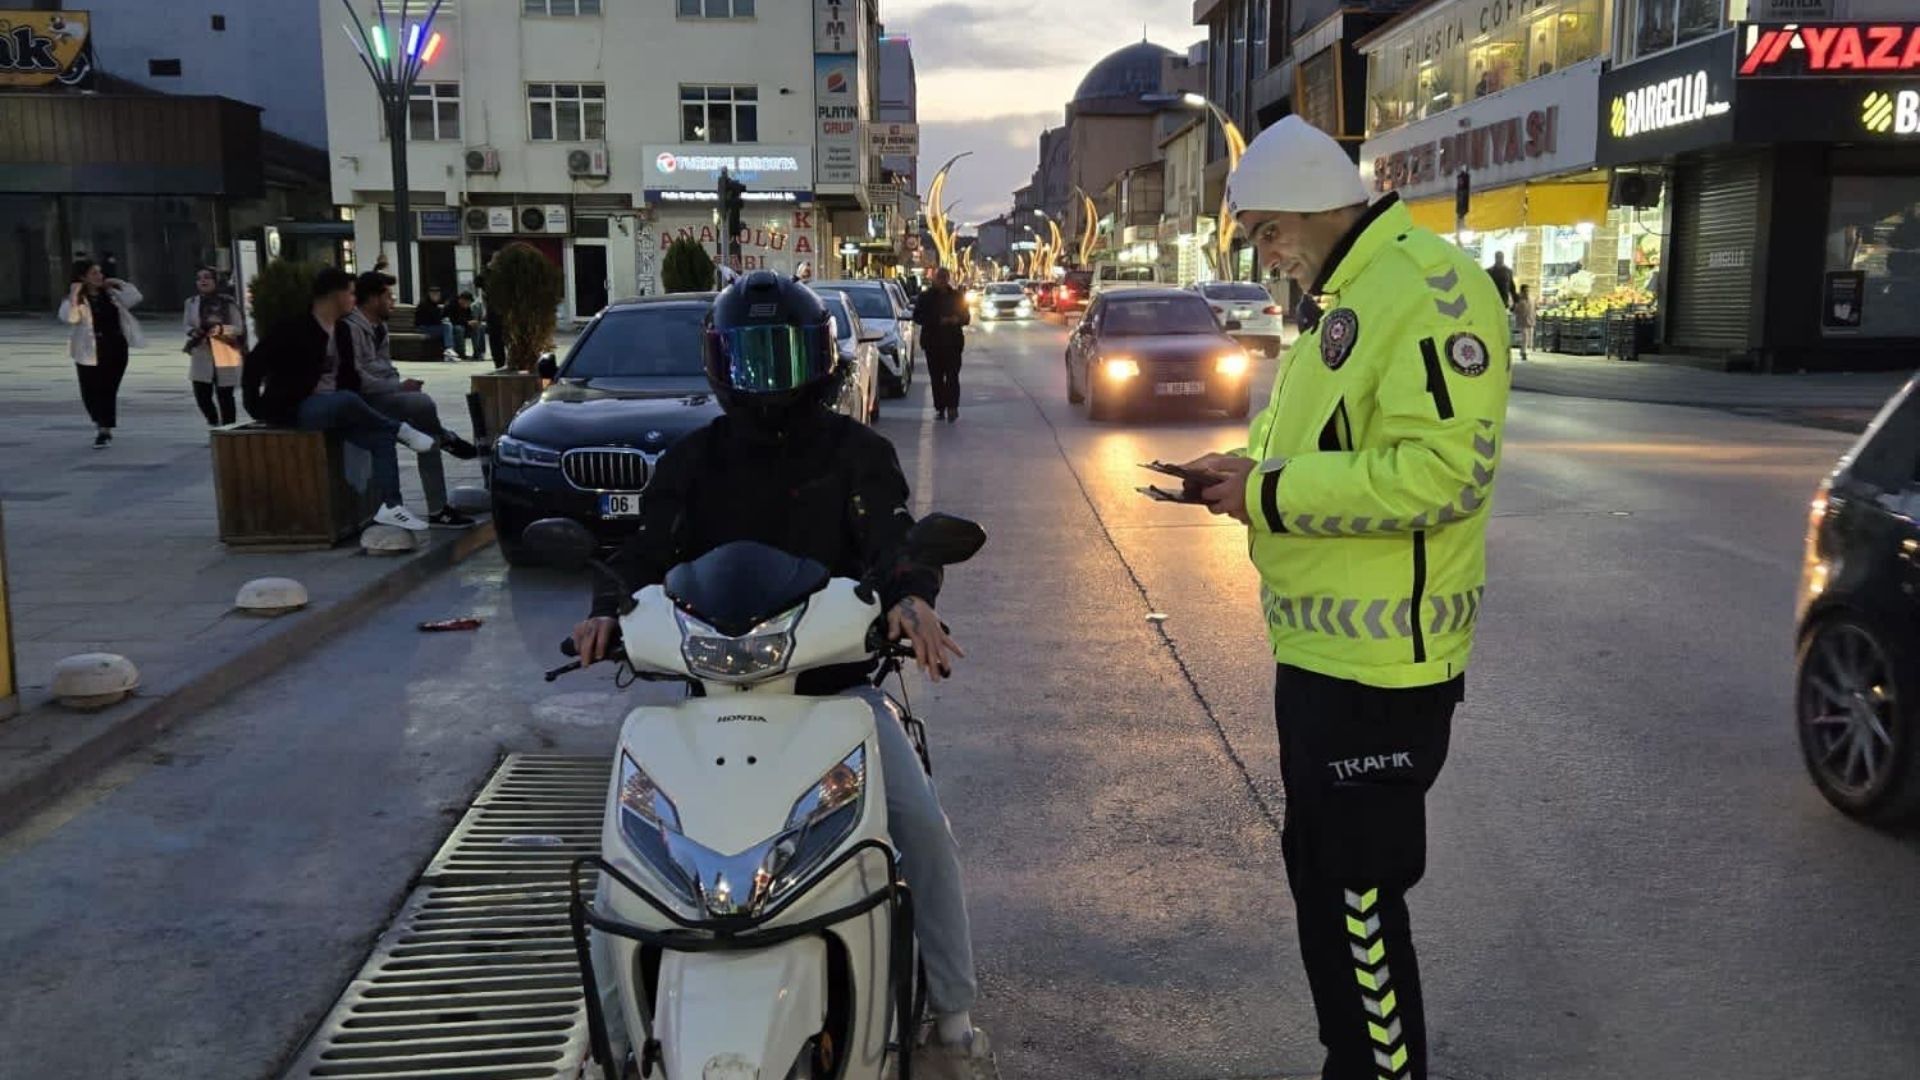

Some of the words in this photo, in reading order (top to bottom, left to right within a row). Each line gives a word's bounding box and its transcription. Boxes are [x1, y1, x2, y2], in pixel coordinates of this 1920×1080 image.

[1625, 70, 1708, 137] BARGELLO
[611, 496, 629, 512] 06
[717, 714, 768, 723] HONDA
